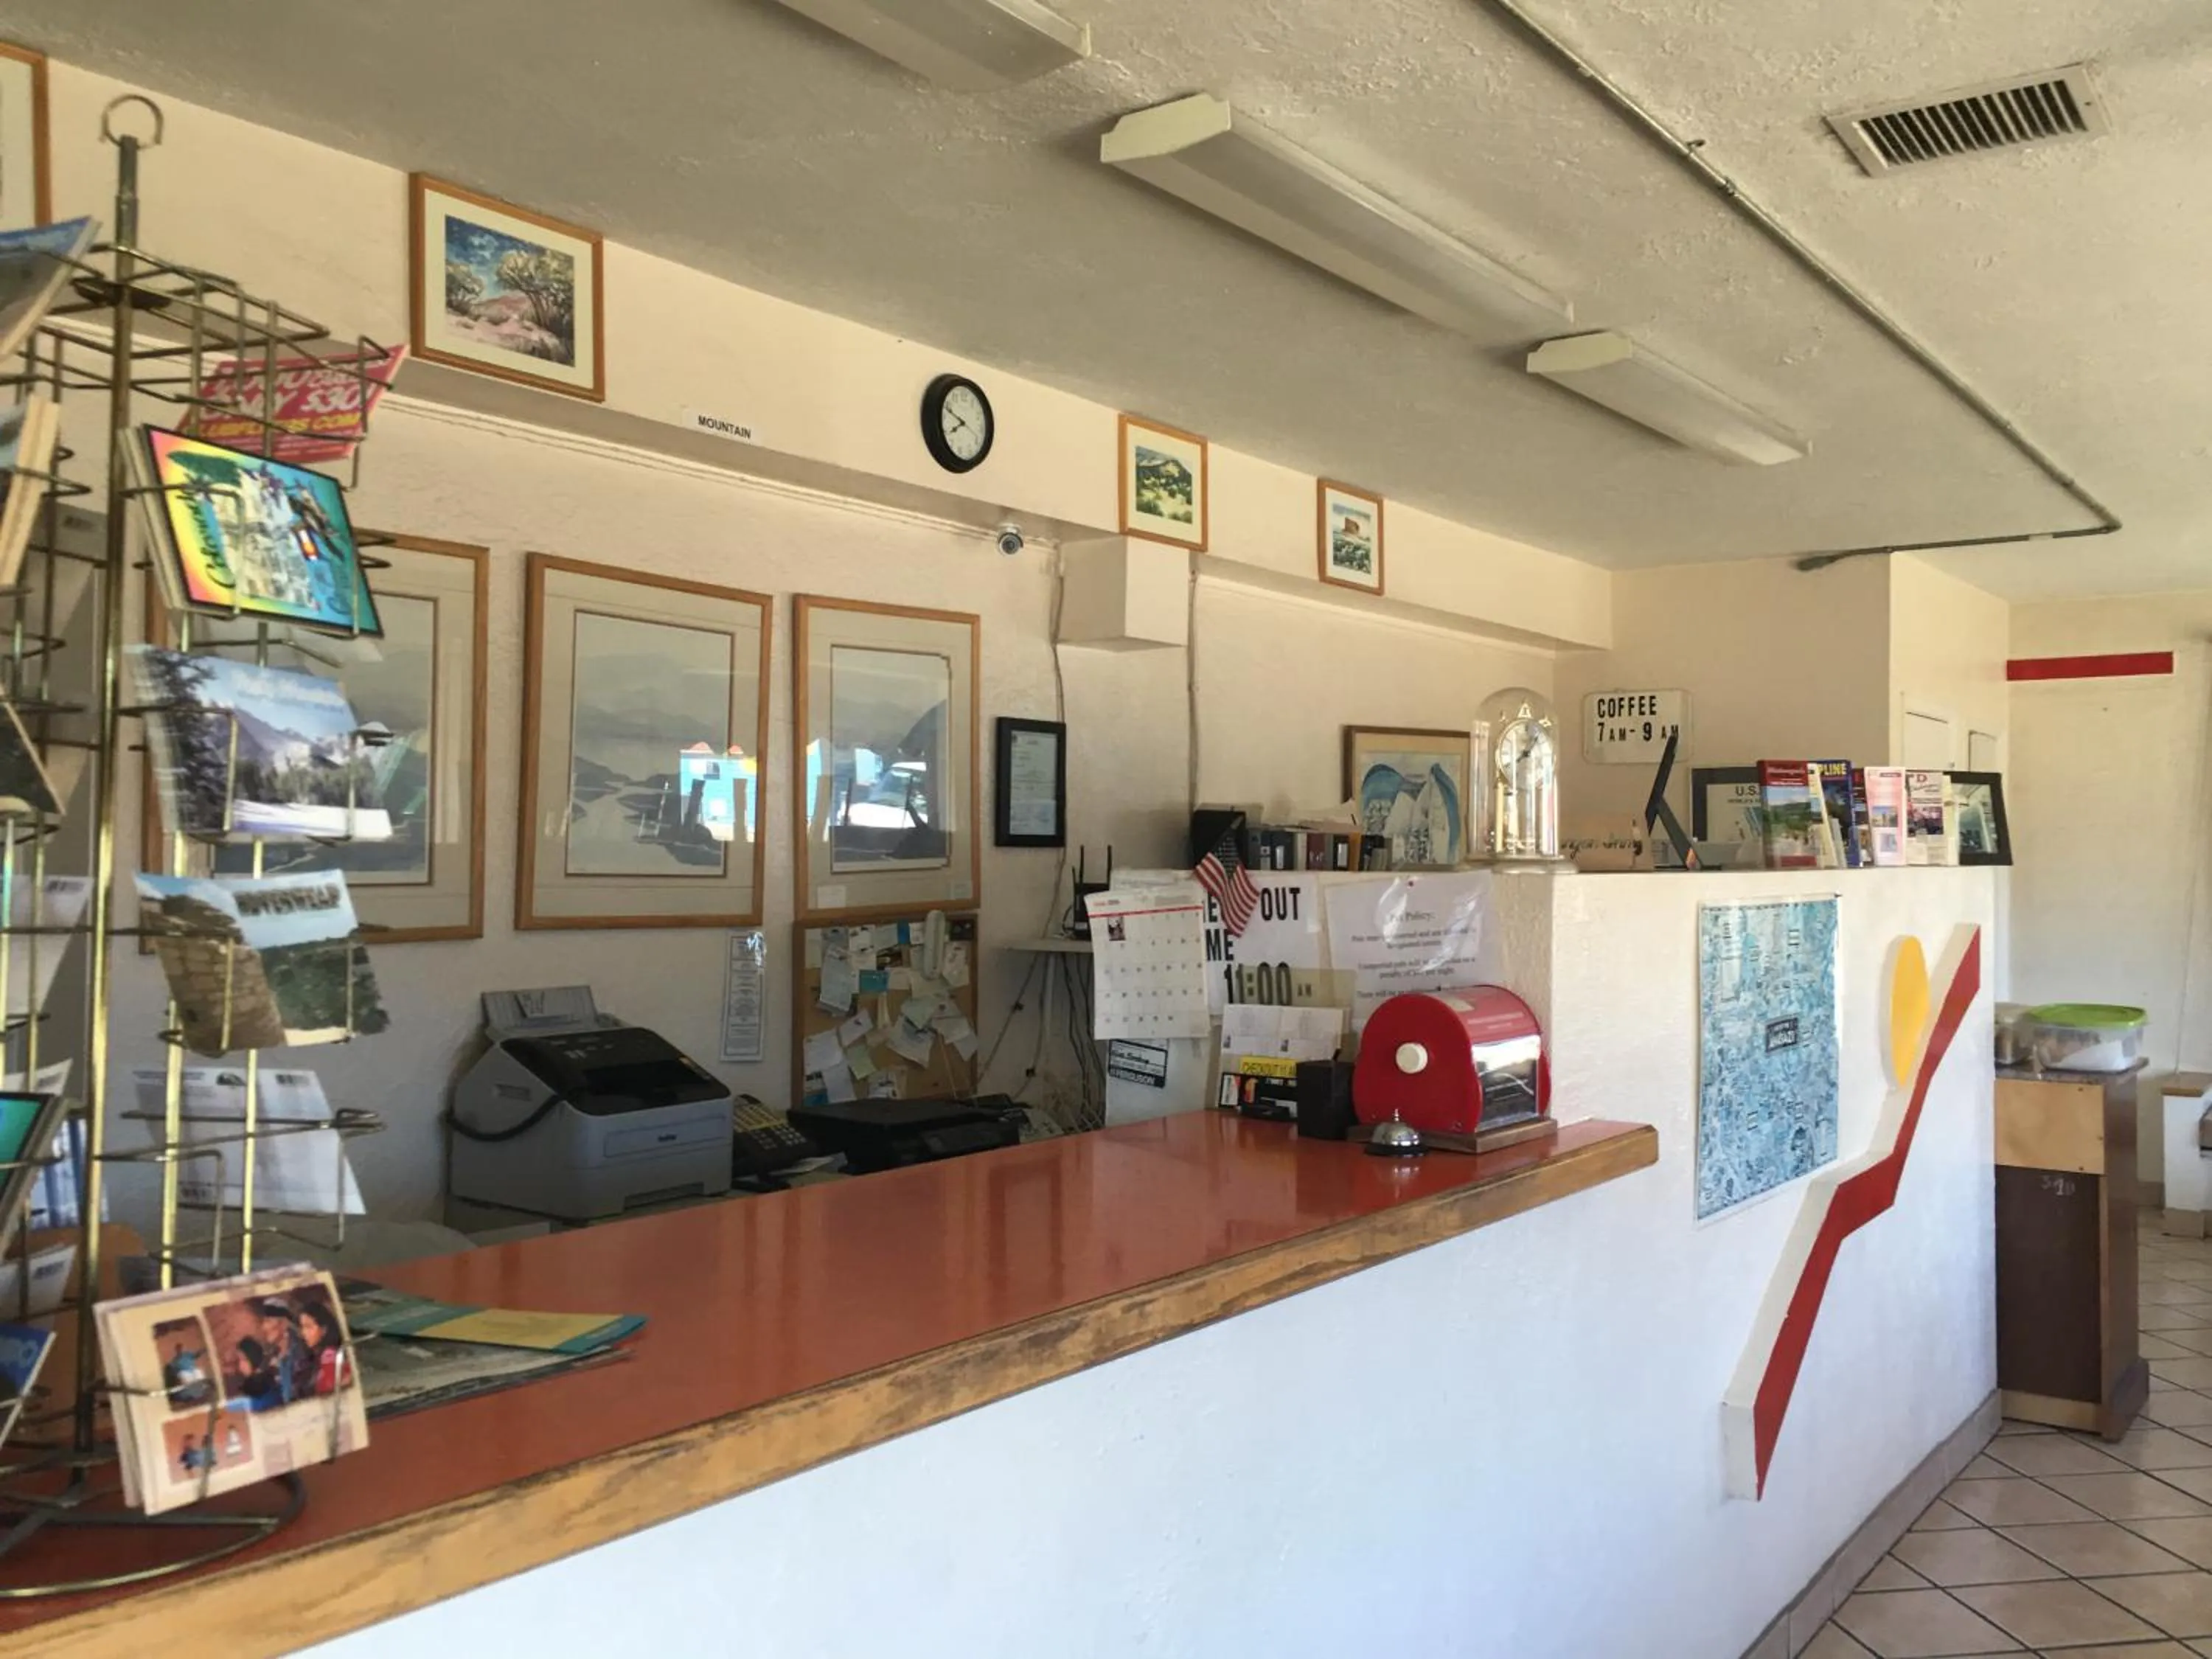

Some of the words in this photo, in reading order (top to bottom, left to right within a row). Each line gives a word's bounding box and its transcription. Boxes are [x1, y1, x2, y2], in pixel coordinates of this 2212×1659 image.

[698, 414, 751, 439] MOUNTAIN
[1597, 695, 1658, 718] COFFEE
[1817, 763, 1847, 776] PLINE
[1260, 887, 1301, 921] OUT
[1206, 928, 1234, 961] ME
[1224, 961, 1293, 1005] 11:00
